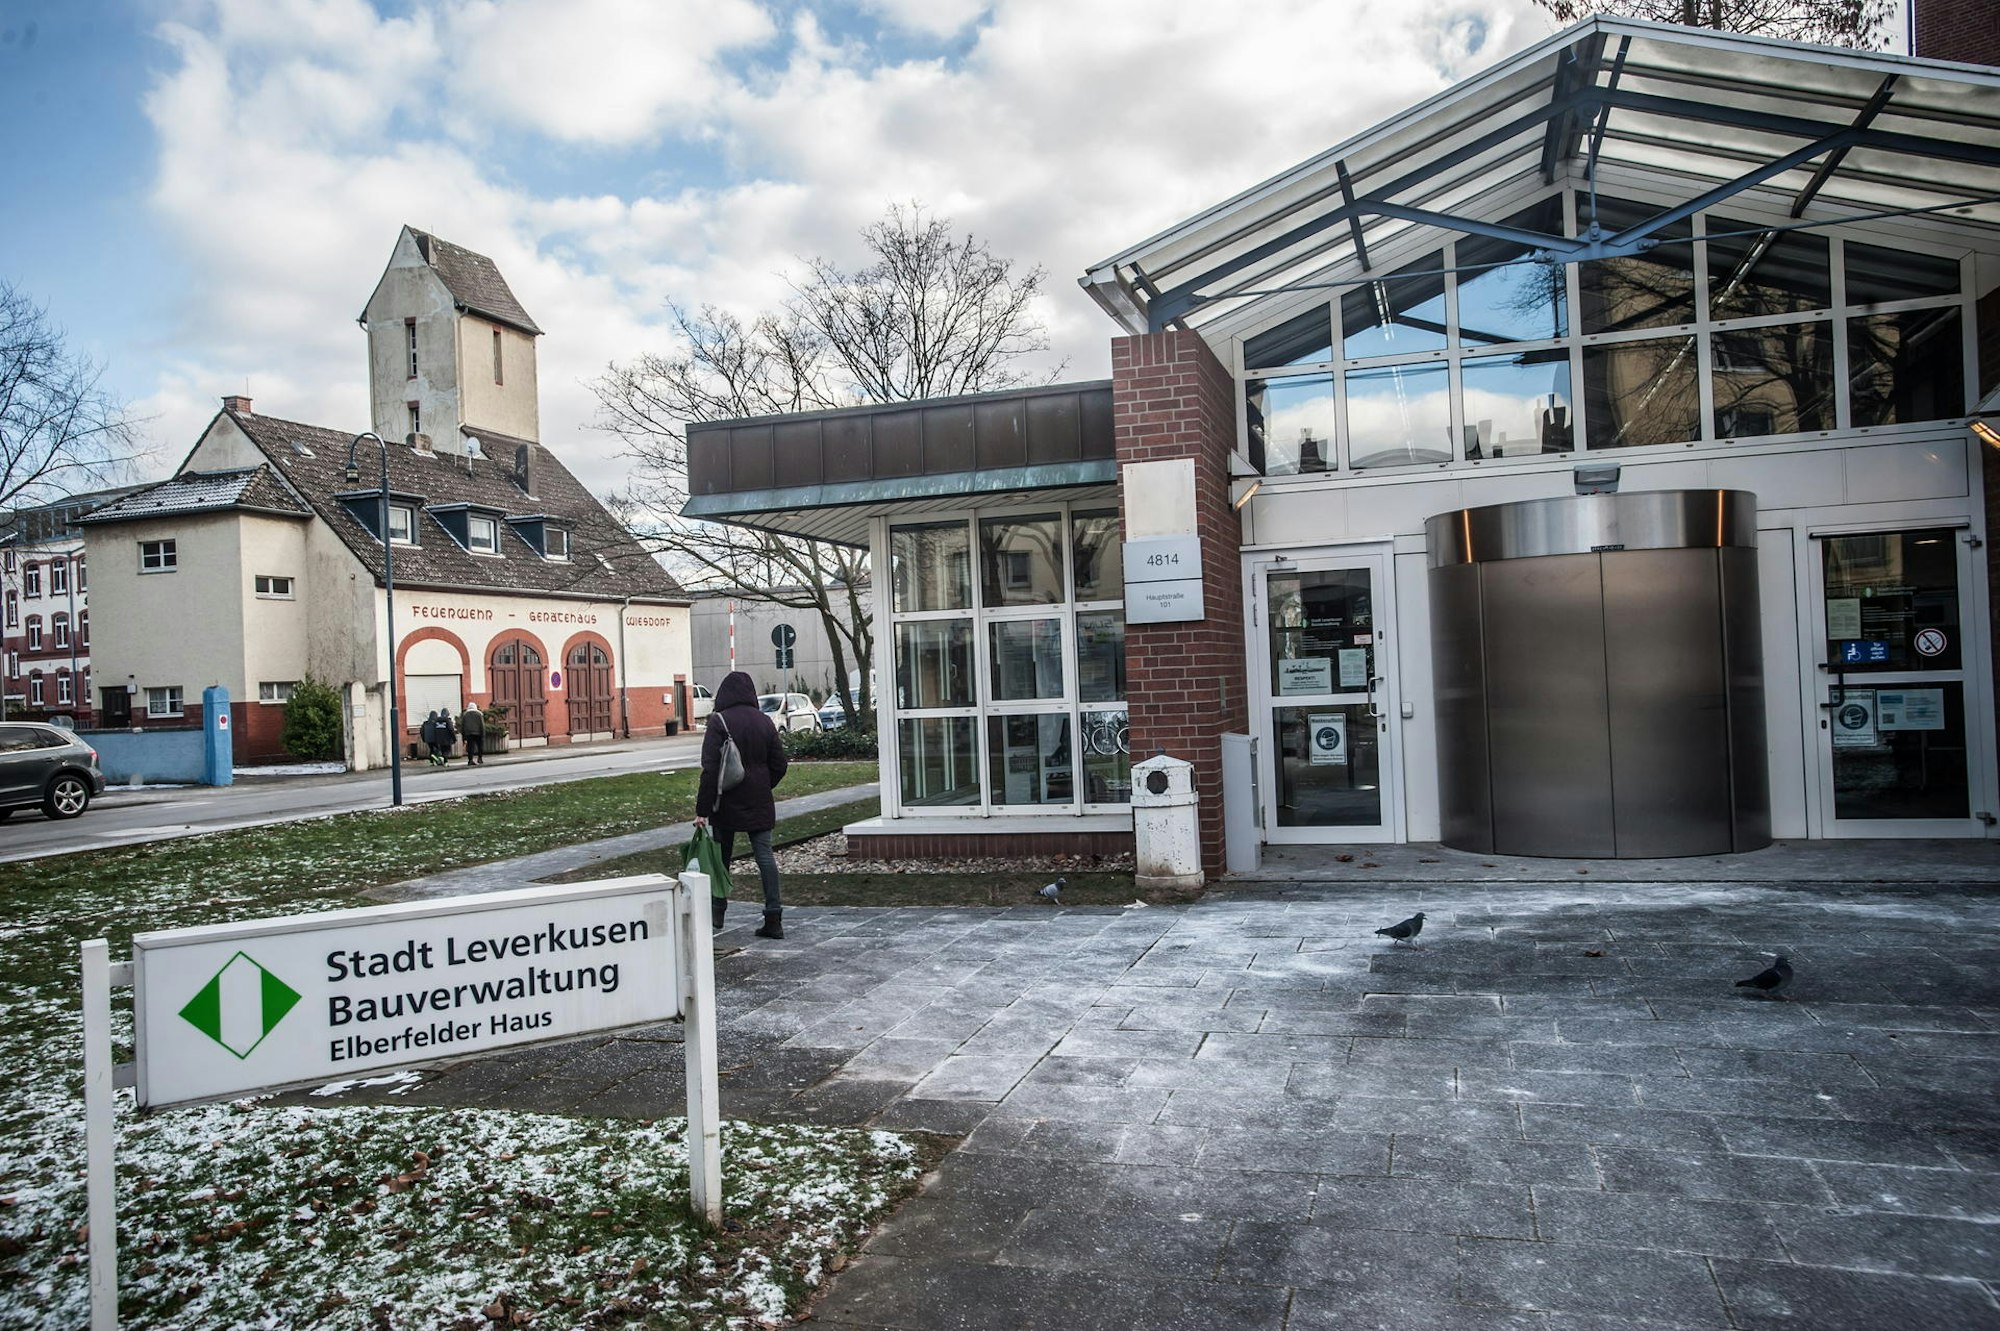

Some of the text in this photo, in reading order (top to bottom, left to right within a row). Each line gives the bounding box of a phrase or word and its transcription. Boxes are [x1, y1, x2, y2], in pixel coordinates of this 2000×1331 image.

[1146, 553, 1180, 566] 4814
[412, 605, 493, 621] FEUERWEHR
[626, 616, 671, 627] WIESDORF
[326, 920, 649, 983] Stadt Leverkusen
[328, 963, 619, 1027] Bauverwaltung
[330, 1011, 552, 1062] Elberfelder Haus
